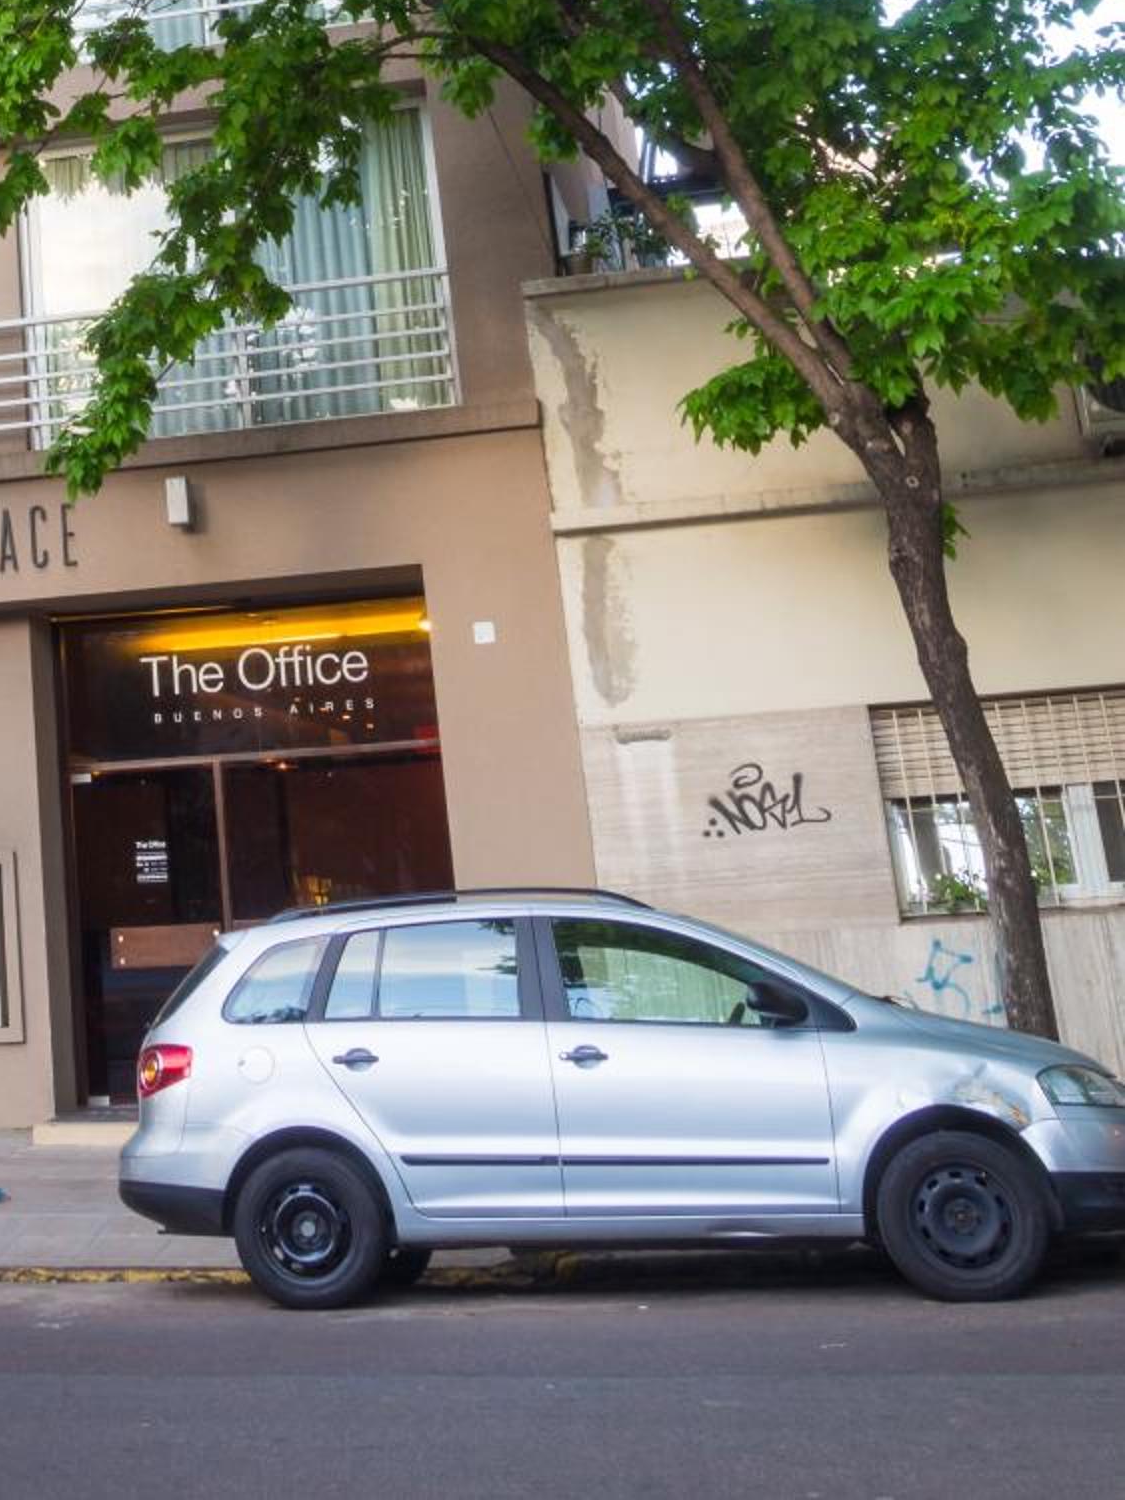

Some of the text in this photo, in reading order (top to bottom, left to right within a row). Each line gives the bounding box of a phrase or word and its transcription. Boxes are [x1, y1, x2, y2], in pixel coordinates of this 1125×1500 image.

[140, 645, 369, 697] The Office
[153, 697, 375, 725] BUENOS AIRES
